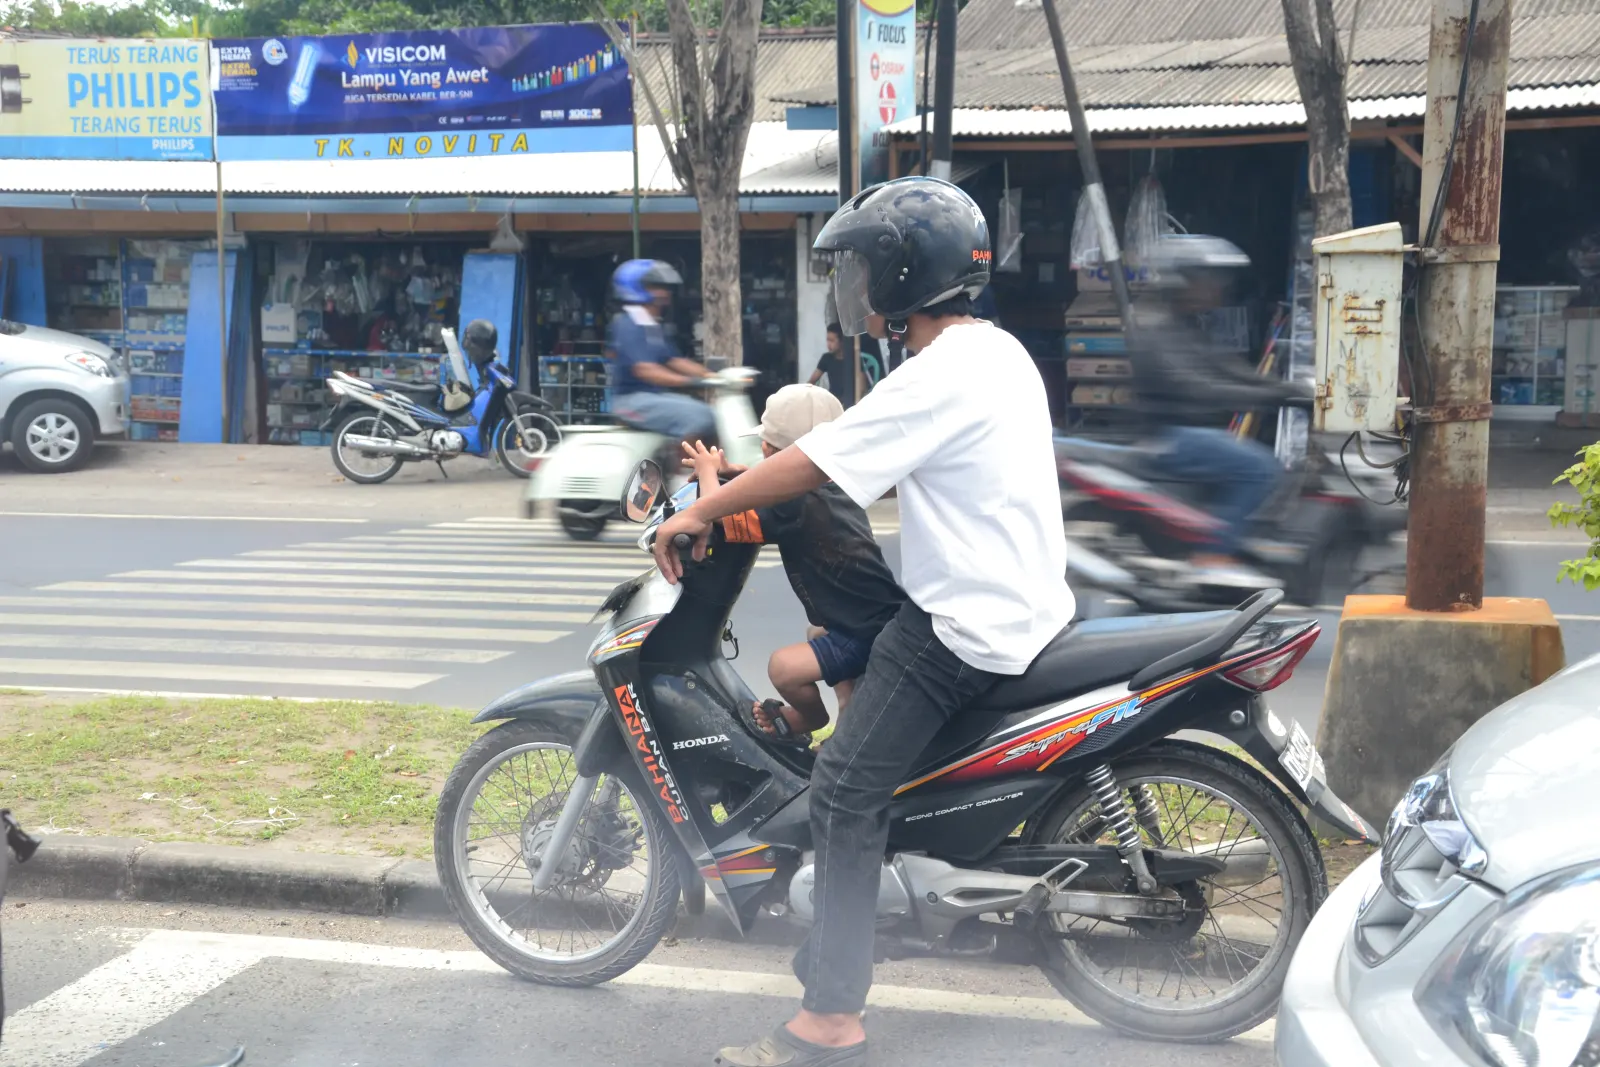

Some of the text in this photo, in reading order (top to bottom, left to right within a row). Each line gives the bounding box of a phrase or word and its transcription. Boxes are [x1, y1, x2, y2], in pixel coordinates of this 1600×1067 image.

[877, 23, 906, 44] FOCUS
[67, 46, 198, 64] TERUS TERANG
[365, 45, 446, 63] VISICOM
[341, 67, 489, 91] Lampu Yang Awet
[68, 72, 200, 108] PHILIPS
[344, 90, 473, 103] JUGA TERSEDIA KABEL BER-SNI
[70, 116, 202, 133] TERANG TERUS
[152, 139, 194, 150] PHILIPS
[387, 133, 529, 156] NOVITA
[626, 681, 689, 822] CUBAN BAR
[672, 733, 731, 751] HONDA
[614, 684, 684, 823] BAHIANA
[905, 791, 1024, 822] ECONO COMPACT COMMUTER
